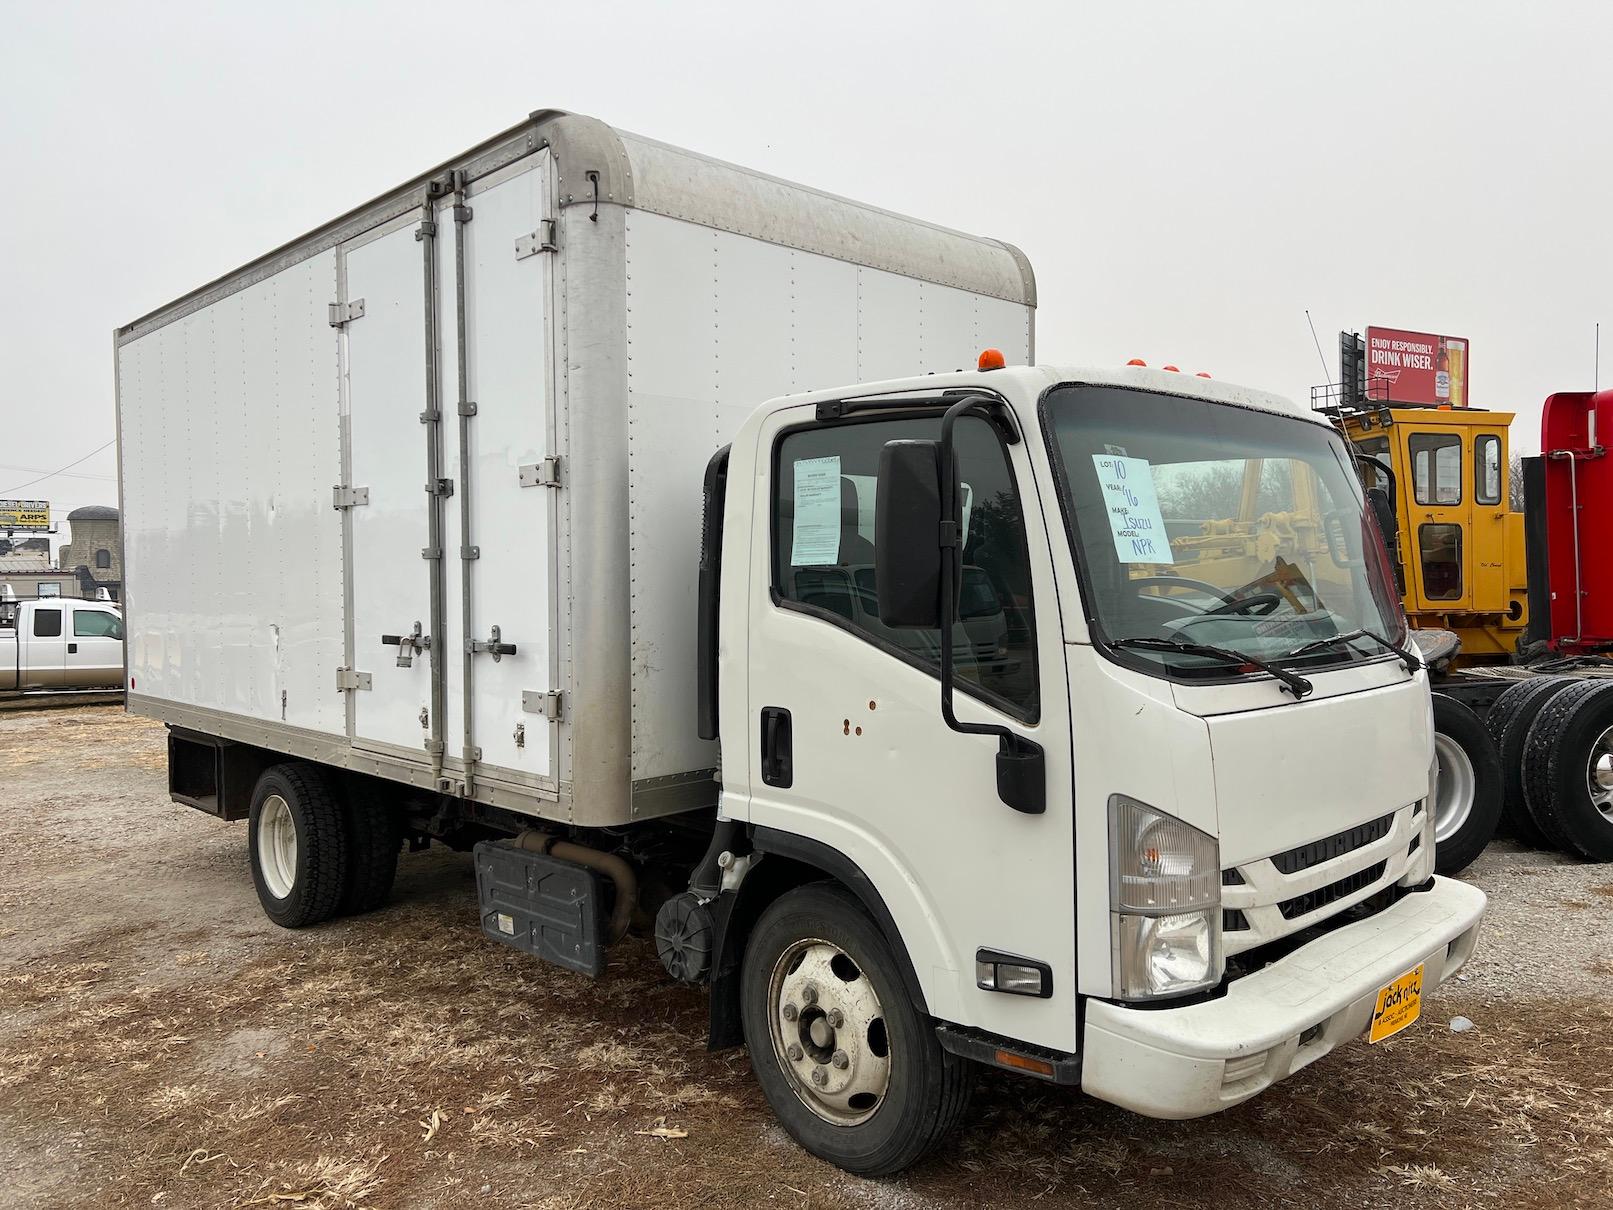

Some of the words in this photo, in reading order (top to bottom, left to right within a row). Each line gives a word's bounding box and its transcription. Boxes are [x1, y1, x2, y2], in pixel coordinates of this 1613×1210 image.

[1371, 338, 1390, 350] ENJOY
[1391, 341, 1433, 354] RESPONSIBLY.
[1371, 349, 1401, 367] DRINK
[1403, 353, 1433, 370] WISER.
[1113, 460, 1126, 480] 10
[1132, 538, 1156, 556] NPR
